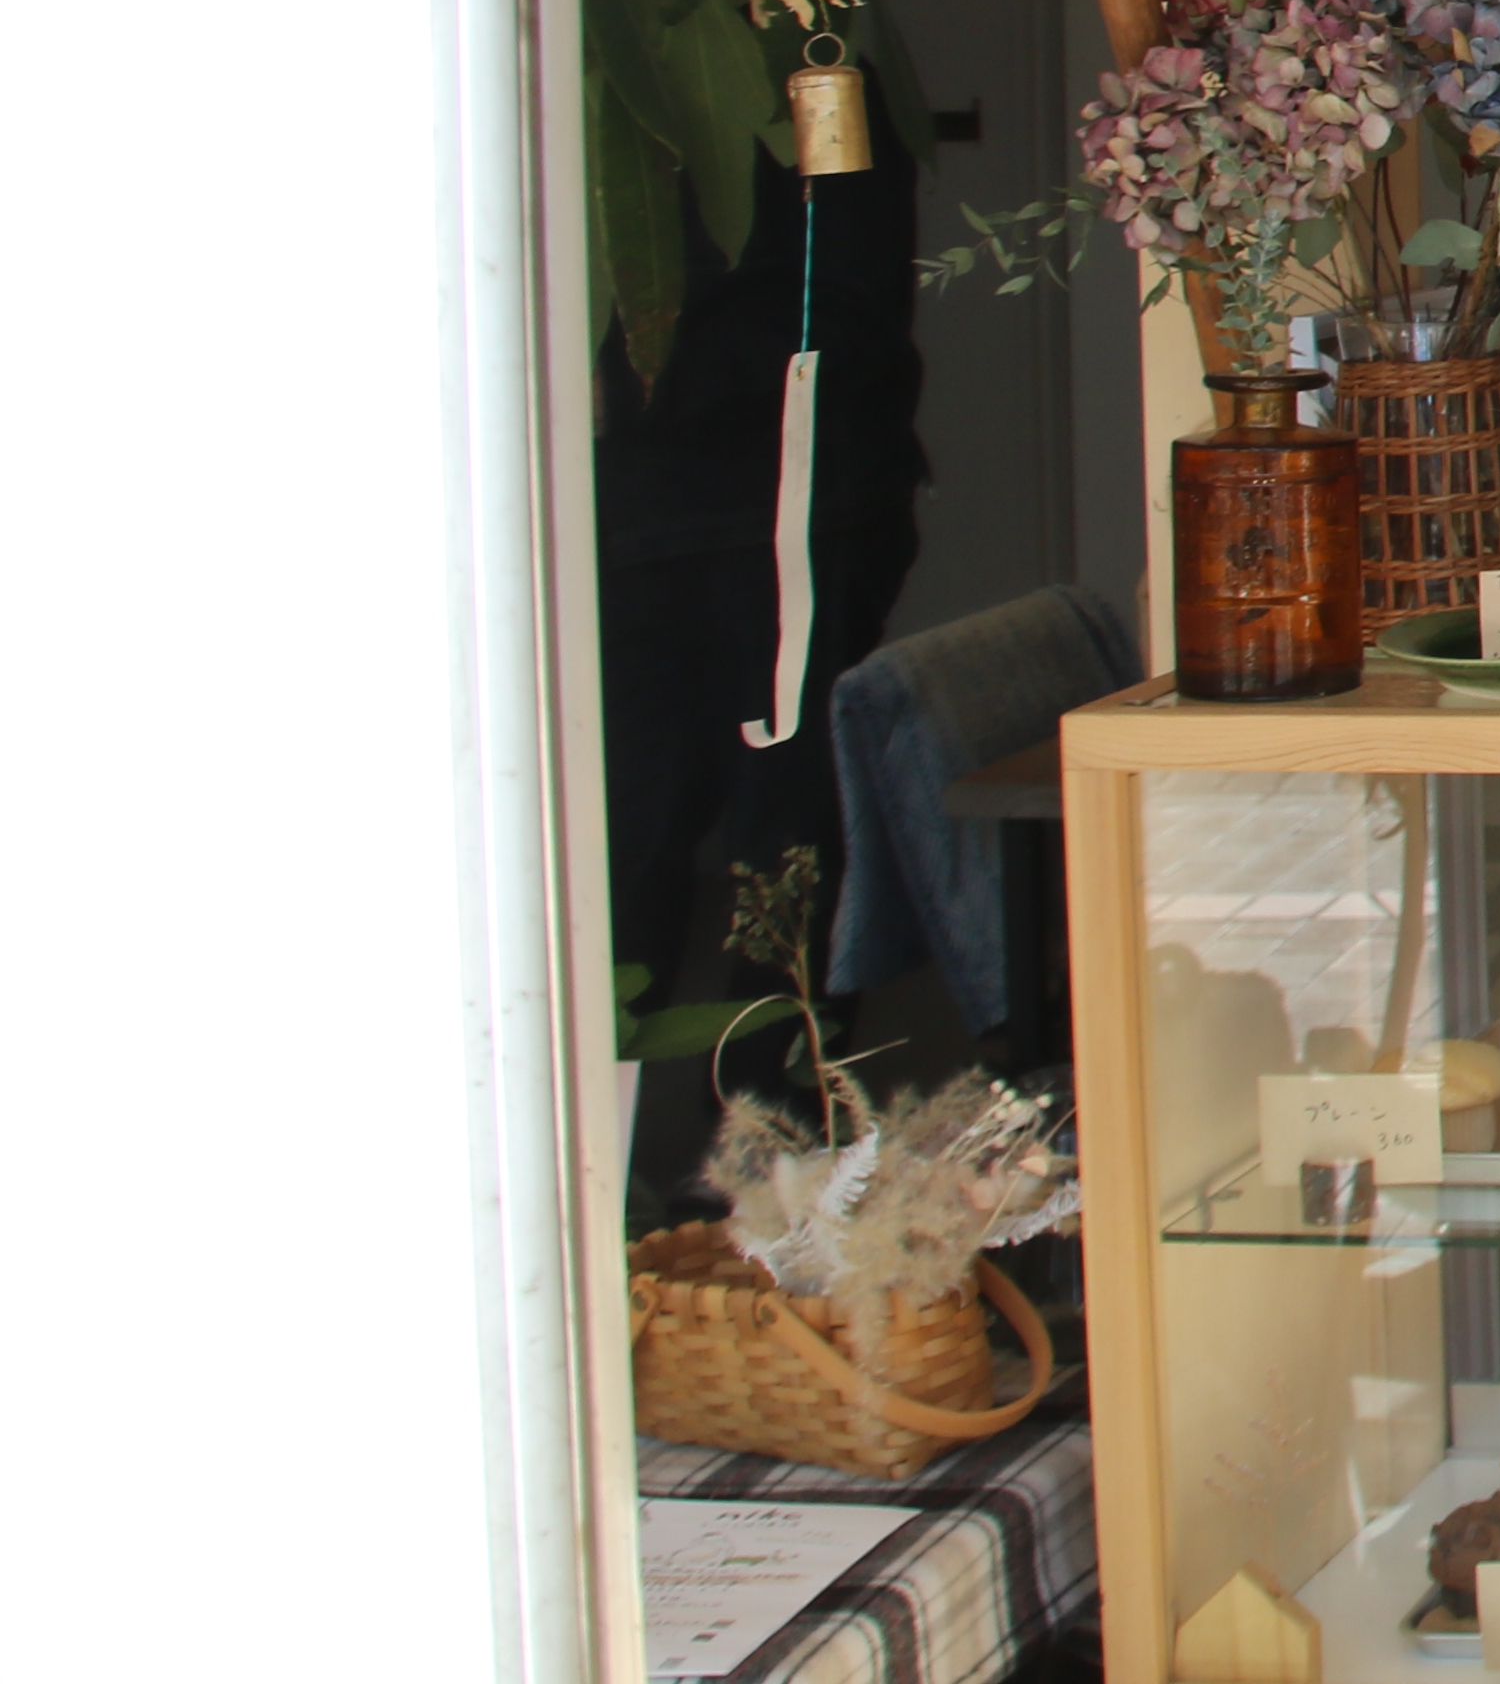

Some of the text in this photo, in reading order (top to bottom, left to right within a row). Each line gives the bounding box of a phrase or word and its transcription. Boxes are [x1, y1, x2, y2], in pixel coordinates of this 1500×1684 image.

[1305, 1099, 1387, 1123] プレーン
[1378, 1132, 1413, 1151] 360
